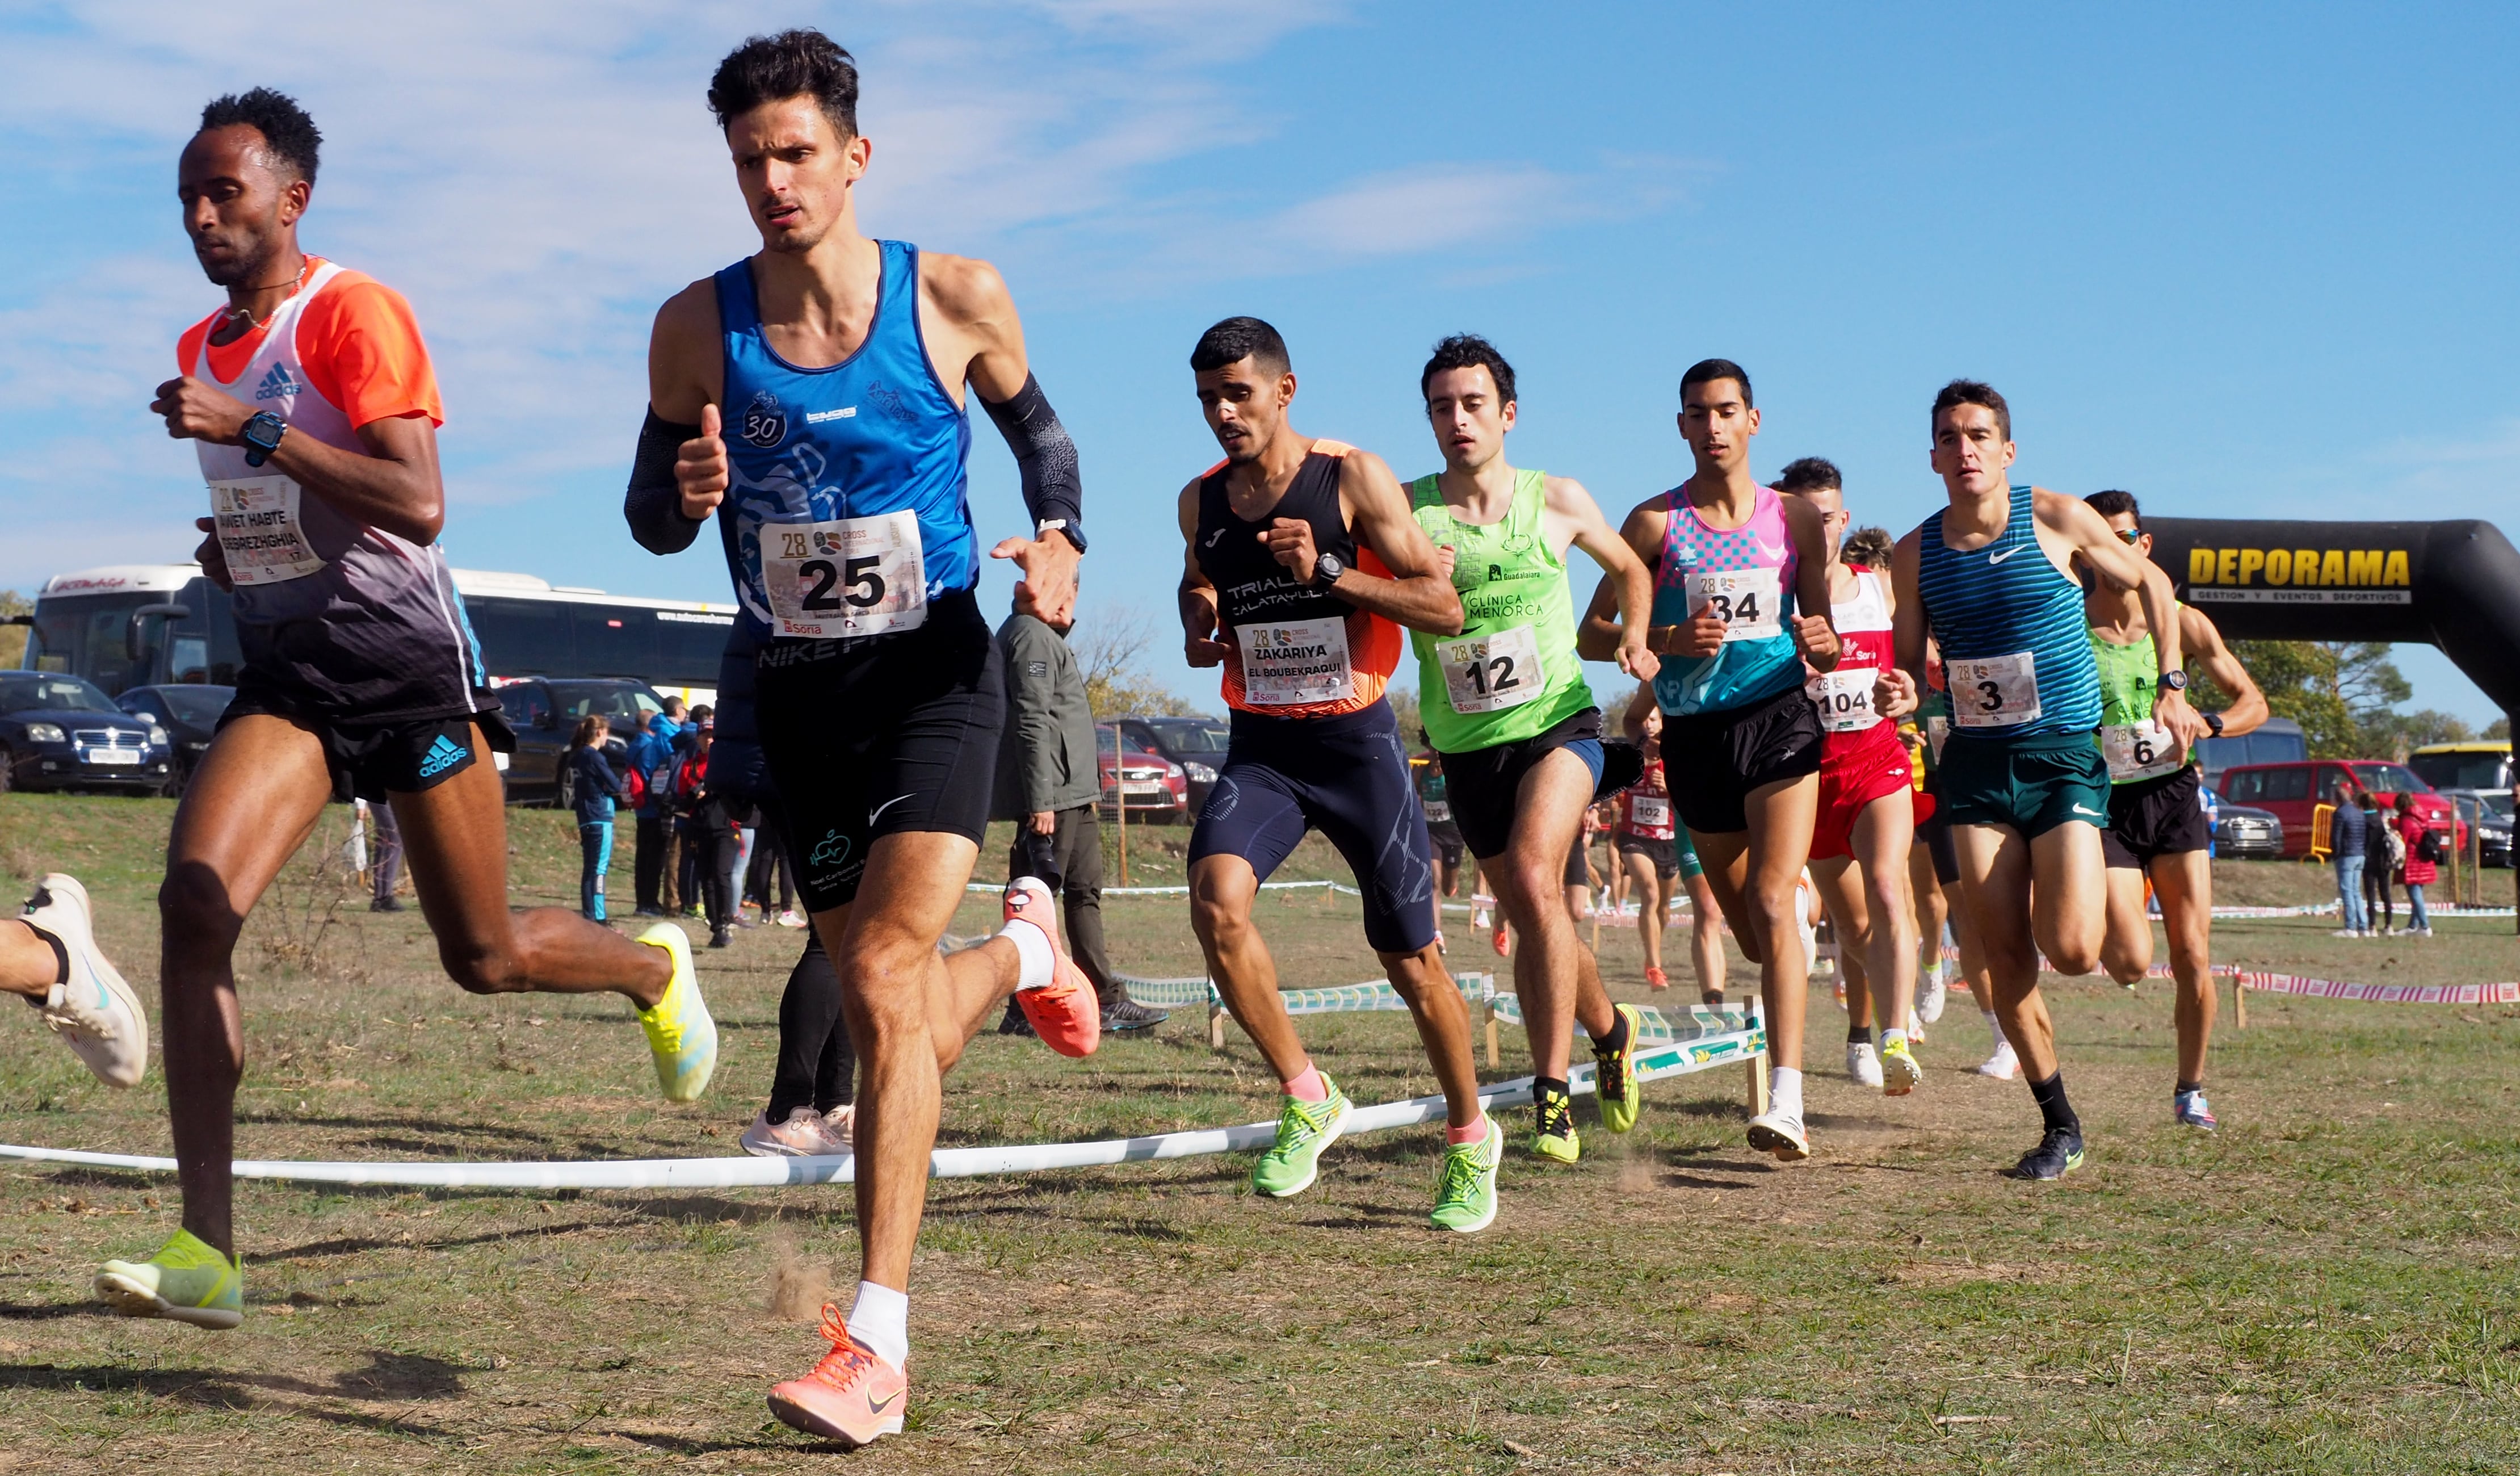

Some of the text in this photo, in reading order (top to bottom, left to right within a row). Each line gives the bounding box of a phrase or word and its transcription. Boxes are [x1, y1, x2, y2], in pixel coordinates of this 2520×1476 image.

[256, 384, 302, 401] adidas
[741, 416, 777, 439] 30
[248, 510, 286, 526] HABTE
[782, 530, 867, 556] 28 CROSS
[2189, 548, 2410, 586] DEPORAMA
[799, 555, 885, 611] 25
[1227, 577, 1303, 599] TRIAL
[1700, 578, 1715, 593] 28
[1469, 594, 1522, 607] CLÍNICA
[2198, 591, 2245, 599] GESTION
[1470, 604, 1543, 619] MENORCA
[1711, 593, 1759, 624] 34
[793, 623, 822, 634] Soria
[1253, 630, 1270, 646] 28
[758, 638, 837, 669] NIKE
[1254, 645, 1327, 660] ZAKARIYA
[1451, 645, 1469, 661] 28
[1856, 651, 1876, 660] Soria
[1263, 663, 1340, 677] BOUBEKRAQUI
[1465, 656, 1519, 694] 12
[1958, 665, 1970, 680] 28
[1816, 678, 1828, 690] 28
[1819, 691, 1867, 714] 104
[1977, 681, 2002, 710] 3
[2114, 729, 2127, 741] 28
[2134, 740, 2154, 765] 6
[419, 748, 467, 777] adidas
[1639, 807, 1660, 816] 102
